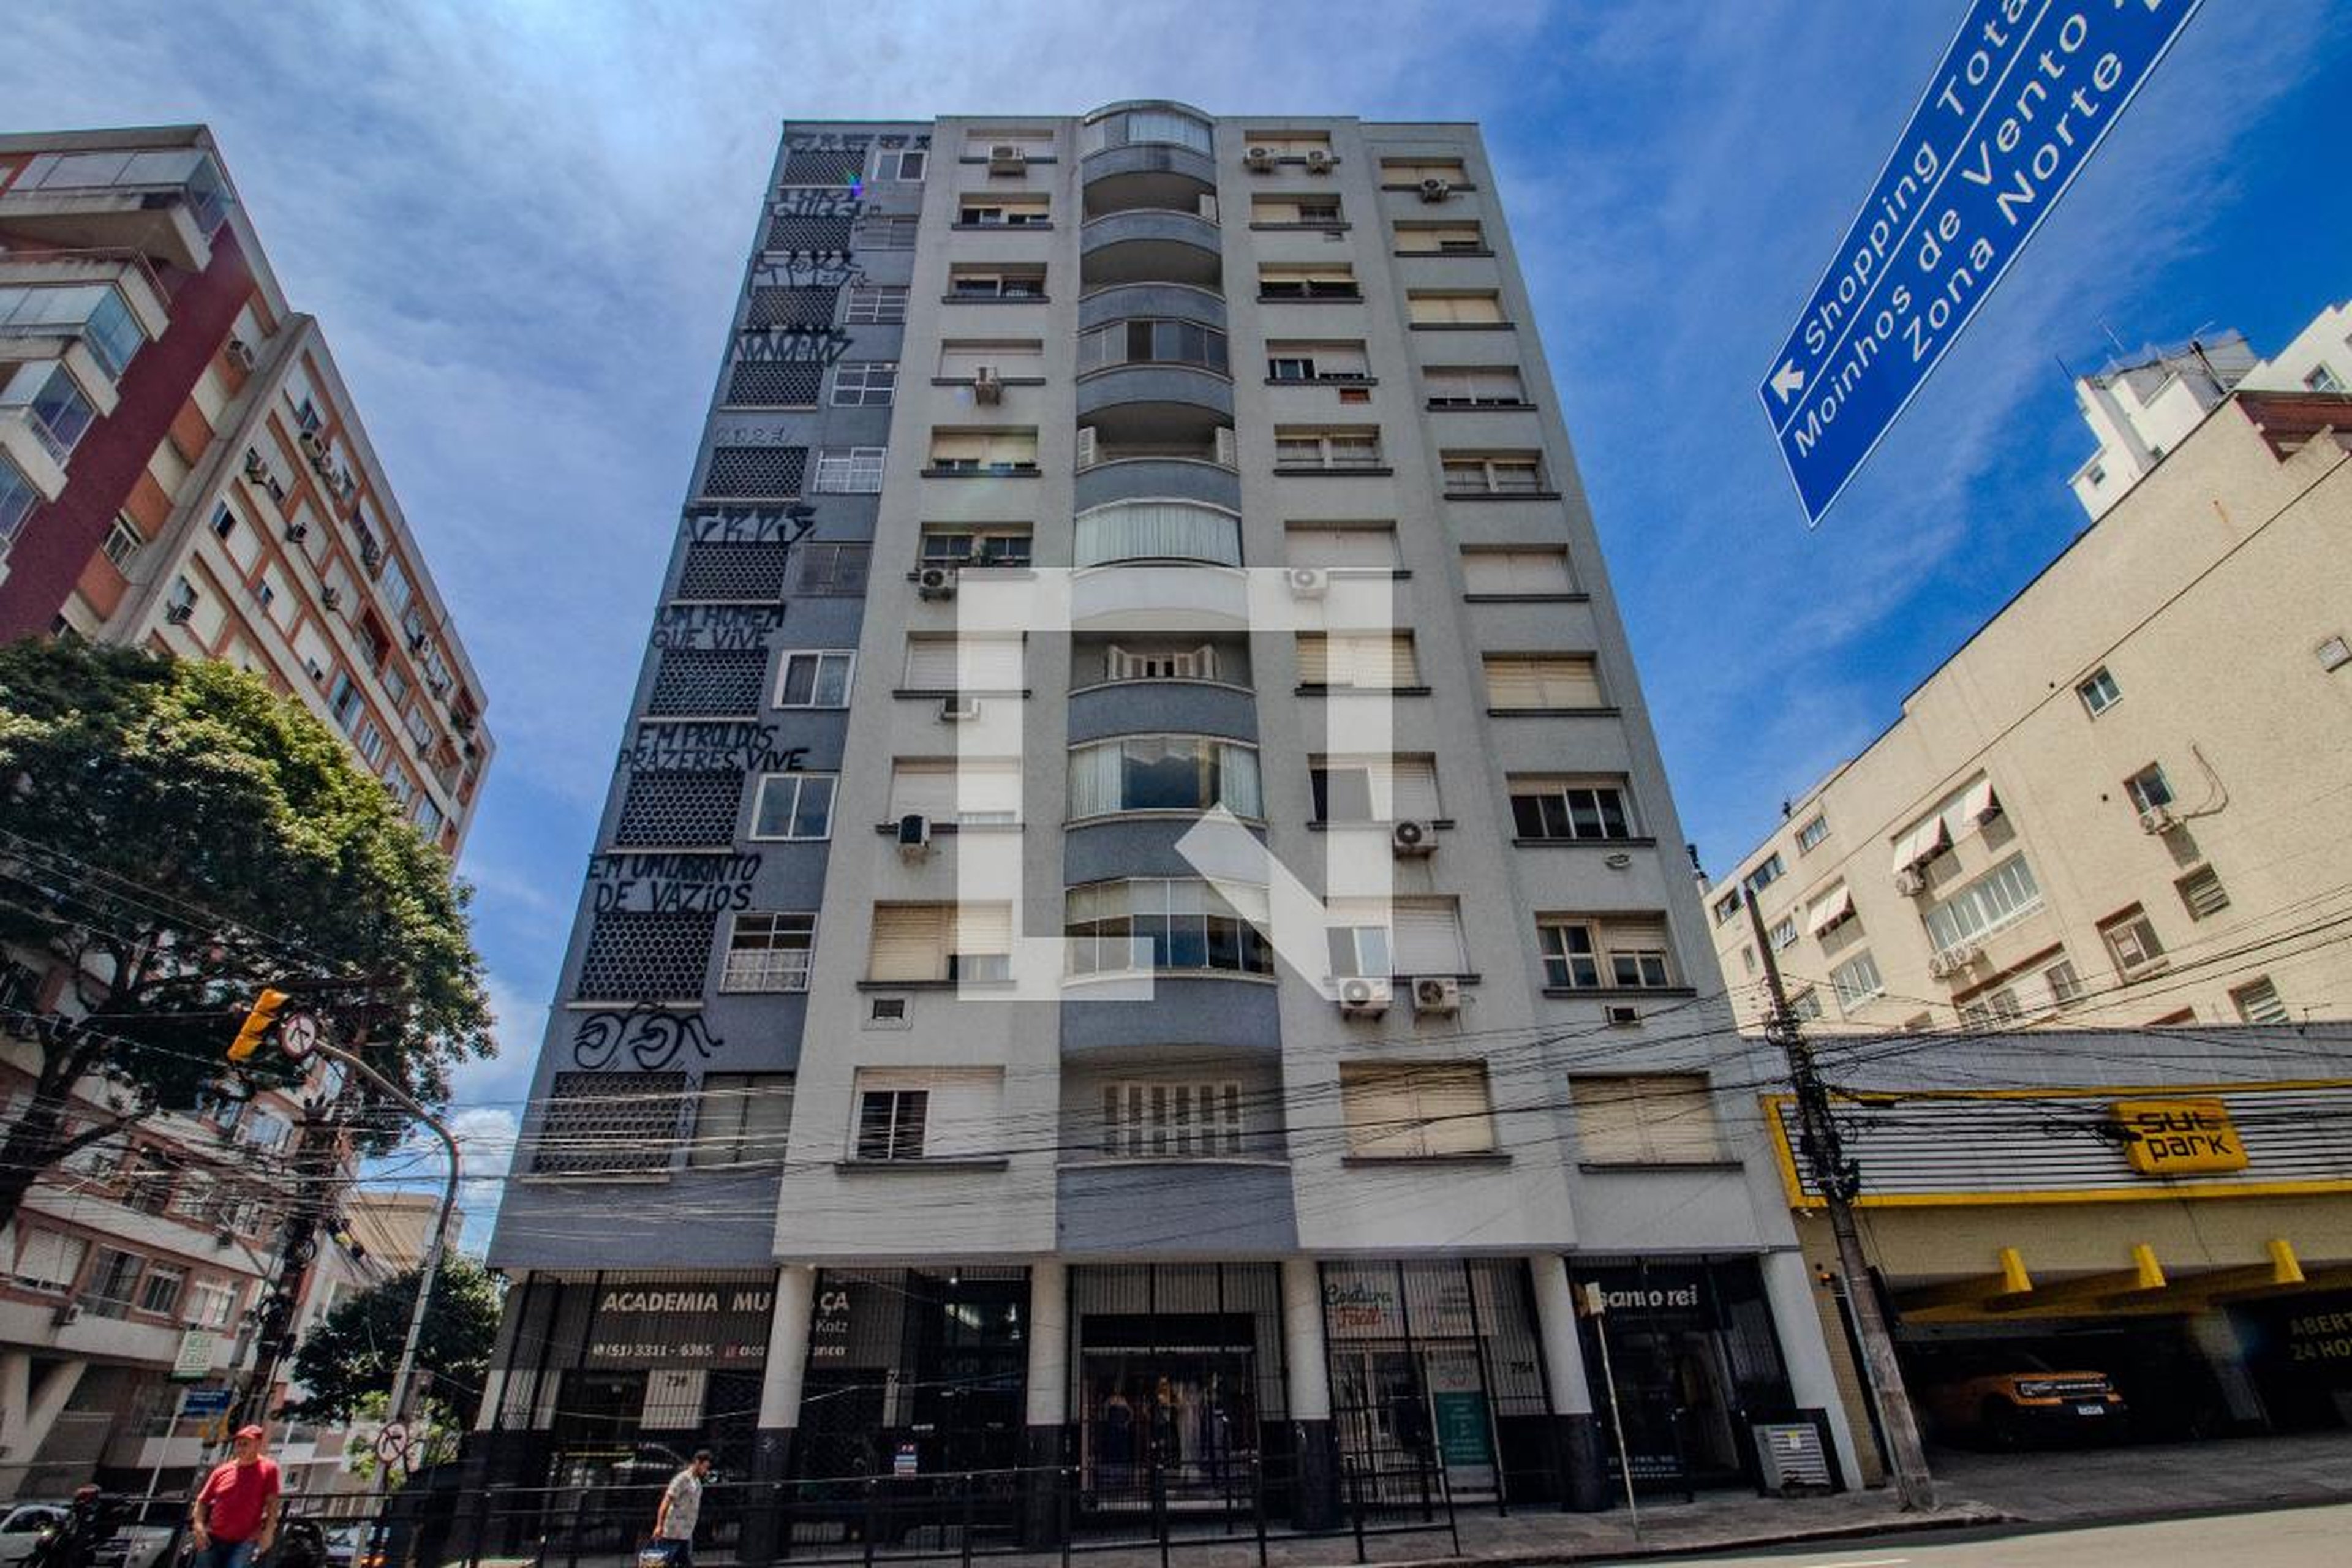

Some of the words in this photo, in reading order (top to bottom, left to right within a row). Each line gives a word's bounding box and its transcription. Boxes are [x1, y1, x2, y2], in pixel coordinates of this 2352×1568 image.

[1903, 238, 1995, 363] Zona
[1997, 52, 2122, 226] Norte
[1795, 288, 1912, 458] Moinhos
[1918, 209, 1961, 273] de
[1962, 13, 2087, 189] Vento
[1805, 142, 1939, 356] Shopping
[652, 629, 703, 649] QUE
[635, 723, 679, 751] EM
[588, 854, 624, 880] EM
[594, 881, 636, 912] DE
[2146, 1132, 2233, 1163] park
[600, 1292, 719, 1312] ACADEMIA
